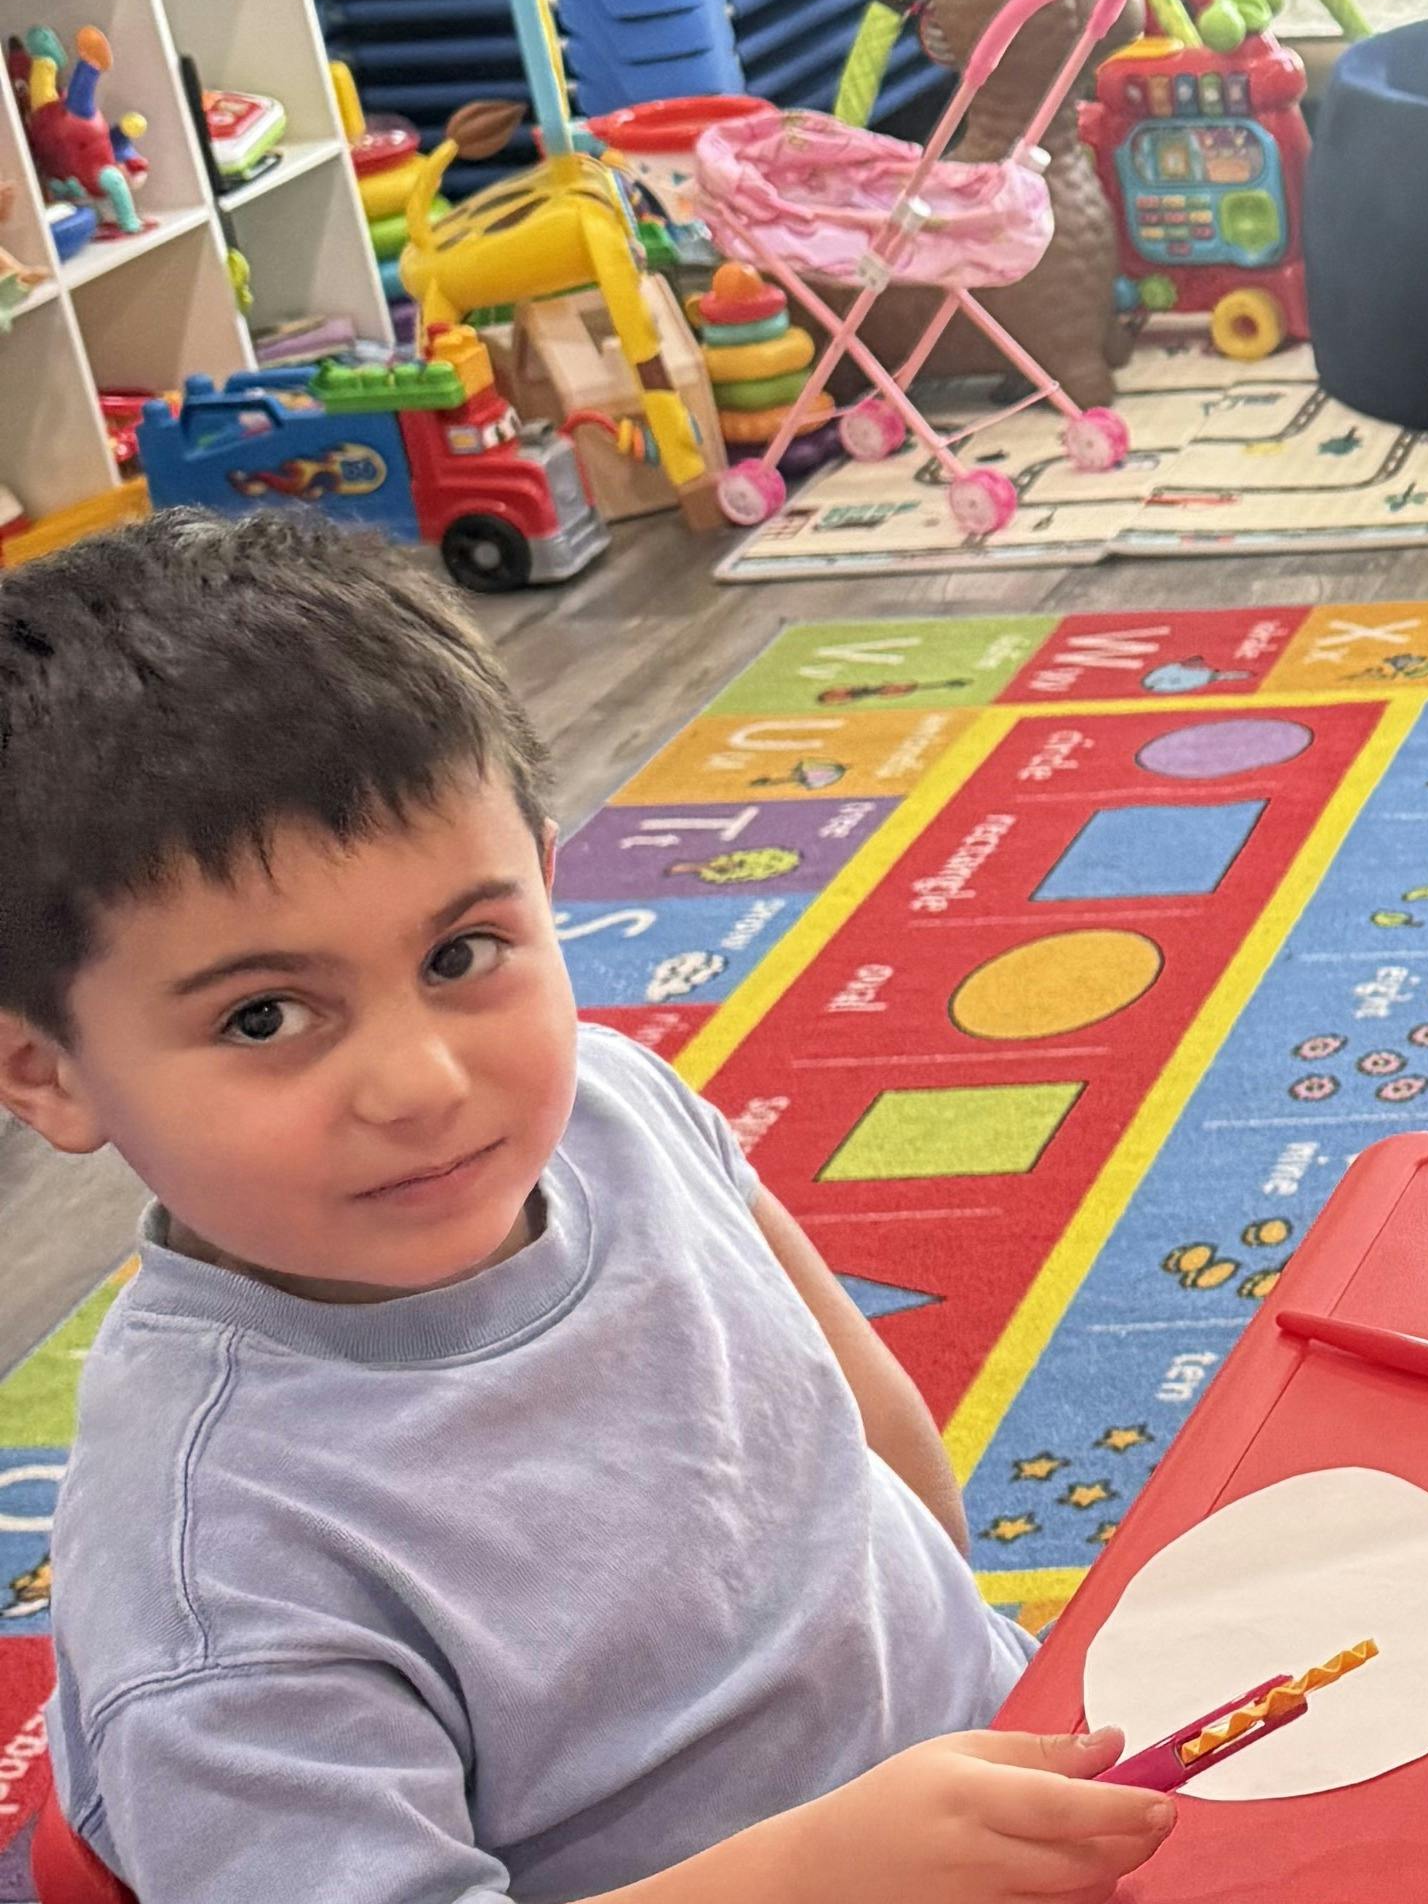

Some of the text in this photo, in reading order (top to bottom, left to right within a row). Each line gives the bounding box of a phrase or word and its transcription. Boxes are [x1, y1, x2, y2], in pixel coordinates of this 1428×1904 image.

[798, 636, 922, 680] Vv
[1027, 624, 1173, 693] Ww
[1304, 618, 1422, 664] Xx
[704, 718, 848, 772] Uu
[1016, 729, 1095, 782] circle
[619, 805, 760, 850] Tt
[907, 813, 1018, 914] rectangle
[824, 963, 895, 1013] oval
[1353, 966, 1422, 1020] eight
[1262, 1140, 1330, 1196] nine
[1155, 1351, 1219, 1403] ten
